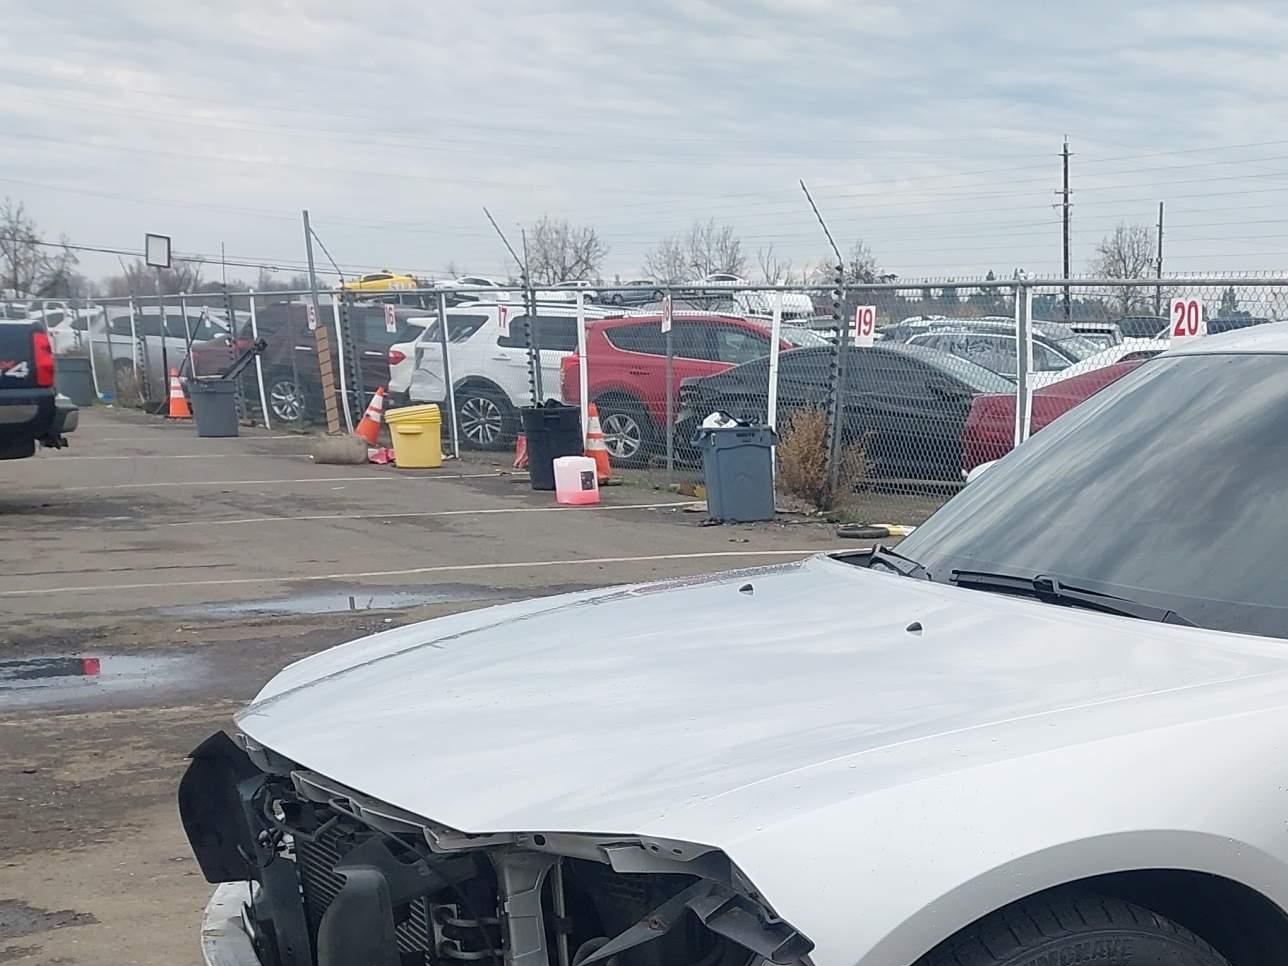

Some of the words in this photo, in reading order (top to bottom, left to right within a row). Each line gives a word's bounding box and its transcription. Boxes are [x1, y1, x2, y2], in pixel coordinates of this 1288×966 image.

[498, 306, 508, 329] 17
[857, 309, 873, 336] 19
[1173, 300, 1199, 336] 20
